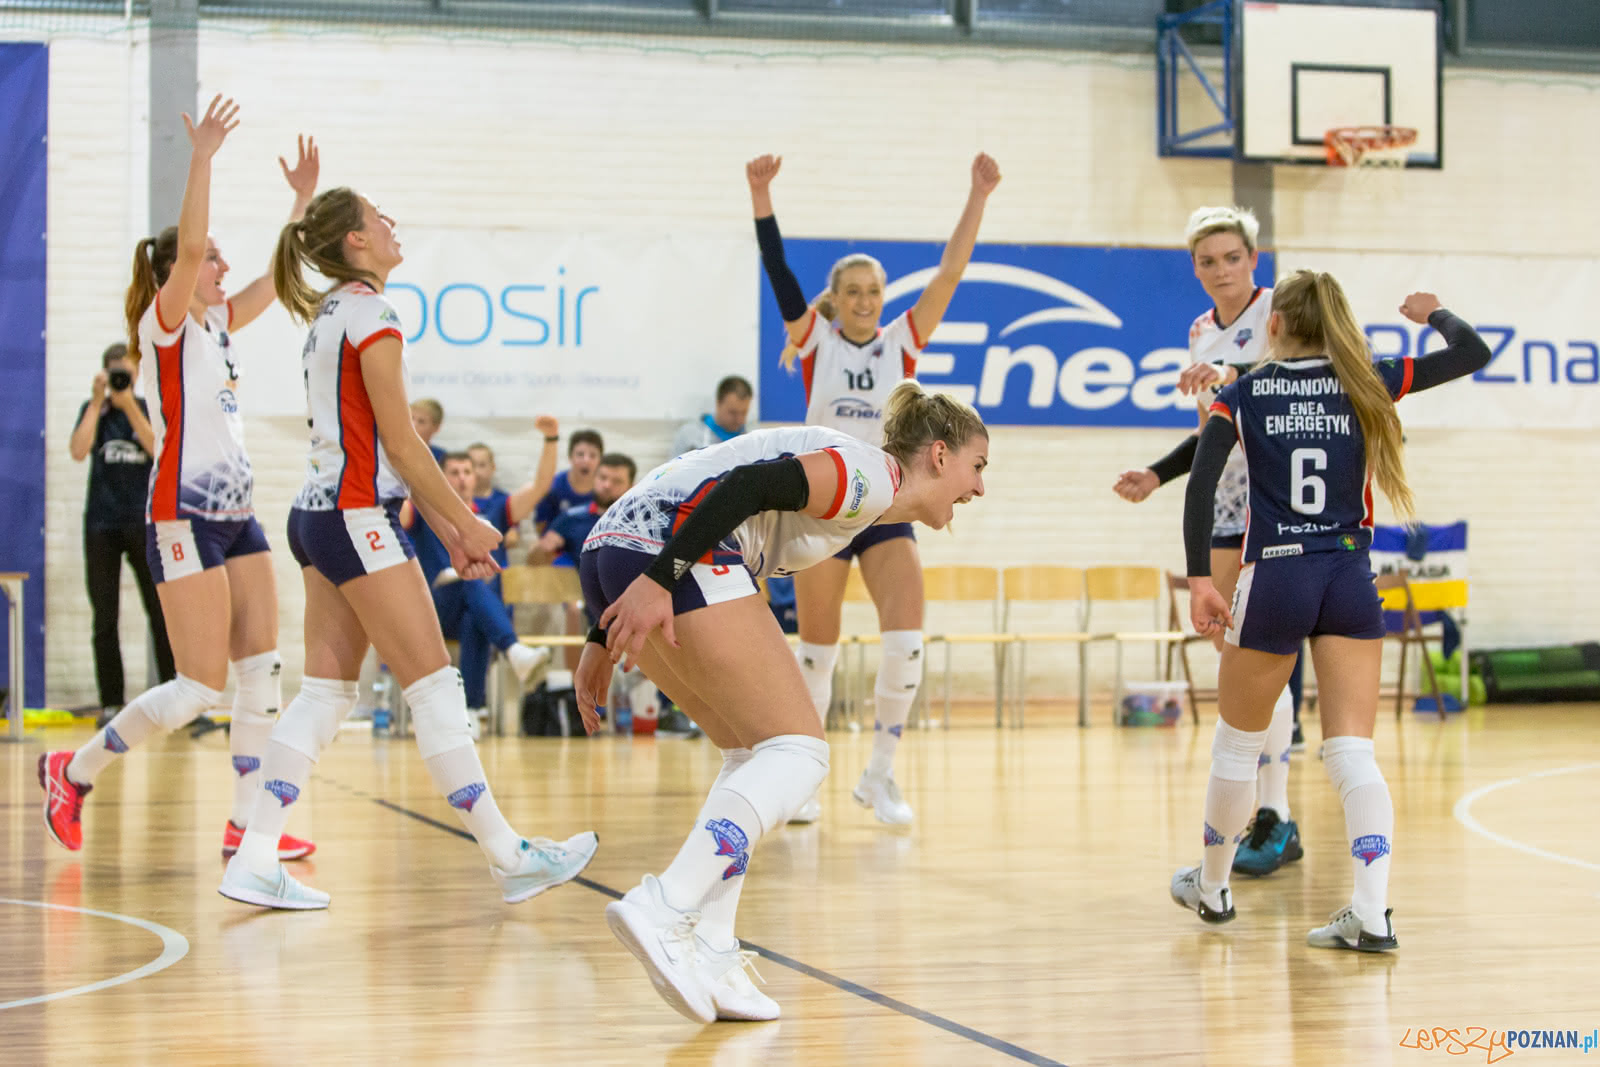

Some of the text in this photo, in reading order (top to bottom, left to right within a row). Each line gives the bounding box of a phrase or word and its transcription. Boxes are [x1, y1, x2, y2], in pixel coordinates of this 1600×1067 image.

[914, 321, 1198, 411] Enea
[843, 368, 874, 391] 10
[1289, 401, 1326, 416] ENEA
[1265, 414, 1351, 436] ENERGETYK
[1290, 447, 1328, 516] 6
[171, 542, 185, 561] 8
[366, 531, 385, 551] 2
